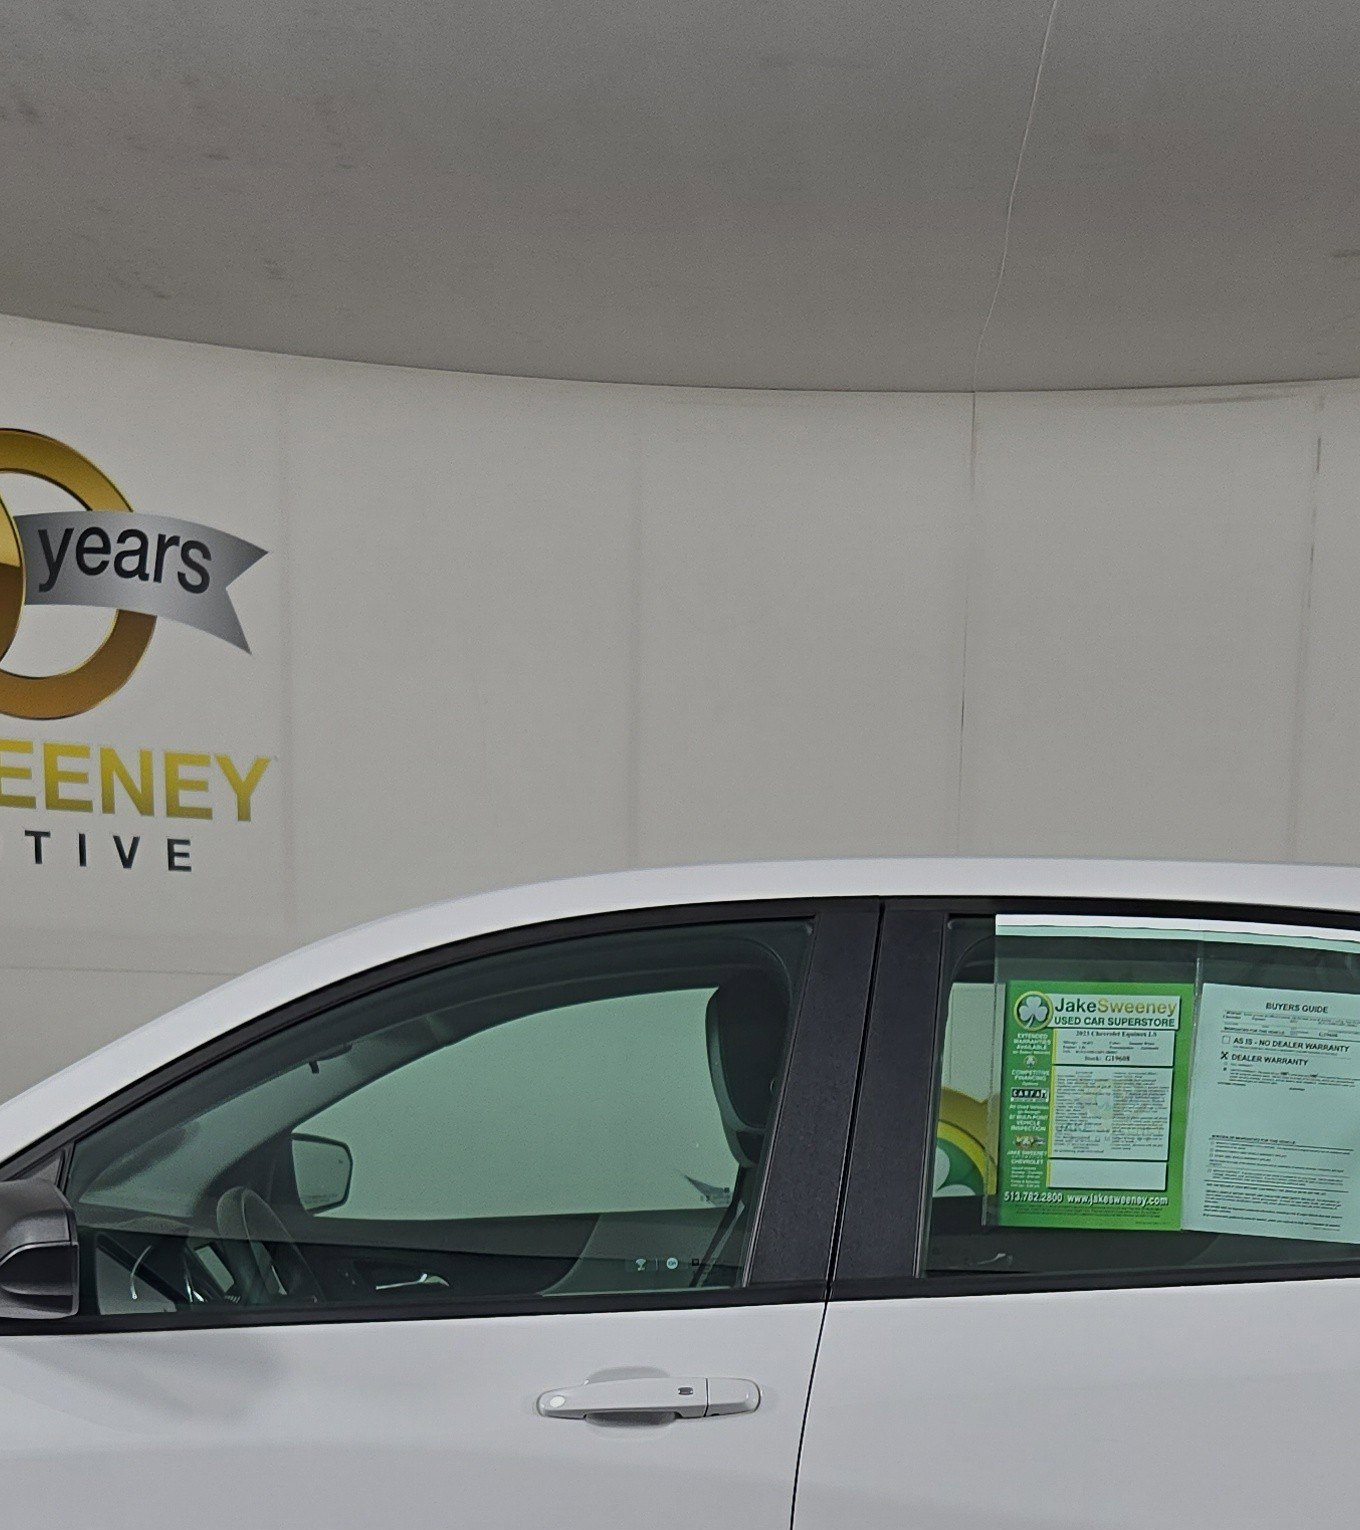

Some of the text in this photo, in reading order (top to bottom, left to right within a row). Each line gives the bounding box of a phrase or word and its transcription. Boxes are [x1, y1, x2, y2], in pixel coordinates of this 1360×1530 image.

[36, 517, 213, 594] years
[1265, 1002, 1329, 1014] BUYERS GUIDE
[1054, 1016, 1176, 1028] USED CAR SUPERSTORE
[1233, 1037, 1244, 1045] AS
[1245, 1038, 1253, 1046] IS
[1259, 1039, 1270, 1047] NO
[1272, 1041, 1305, 1050] DEALER
[1305, 1042, 1350, 1053] WARRANTY
[1231, 1053, 1263, 1063] DEALER
[1264, 1055, 1309, 1066] WARRANTY
[1003, 1191, 1169, 1207] 513.782.2800 www.jakesweeney.com
